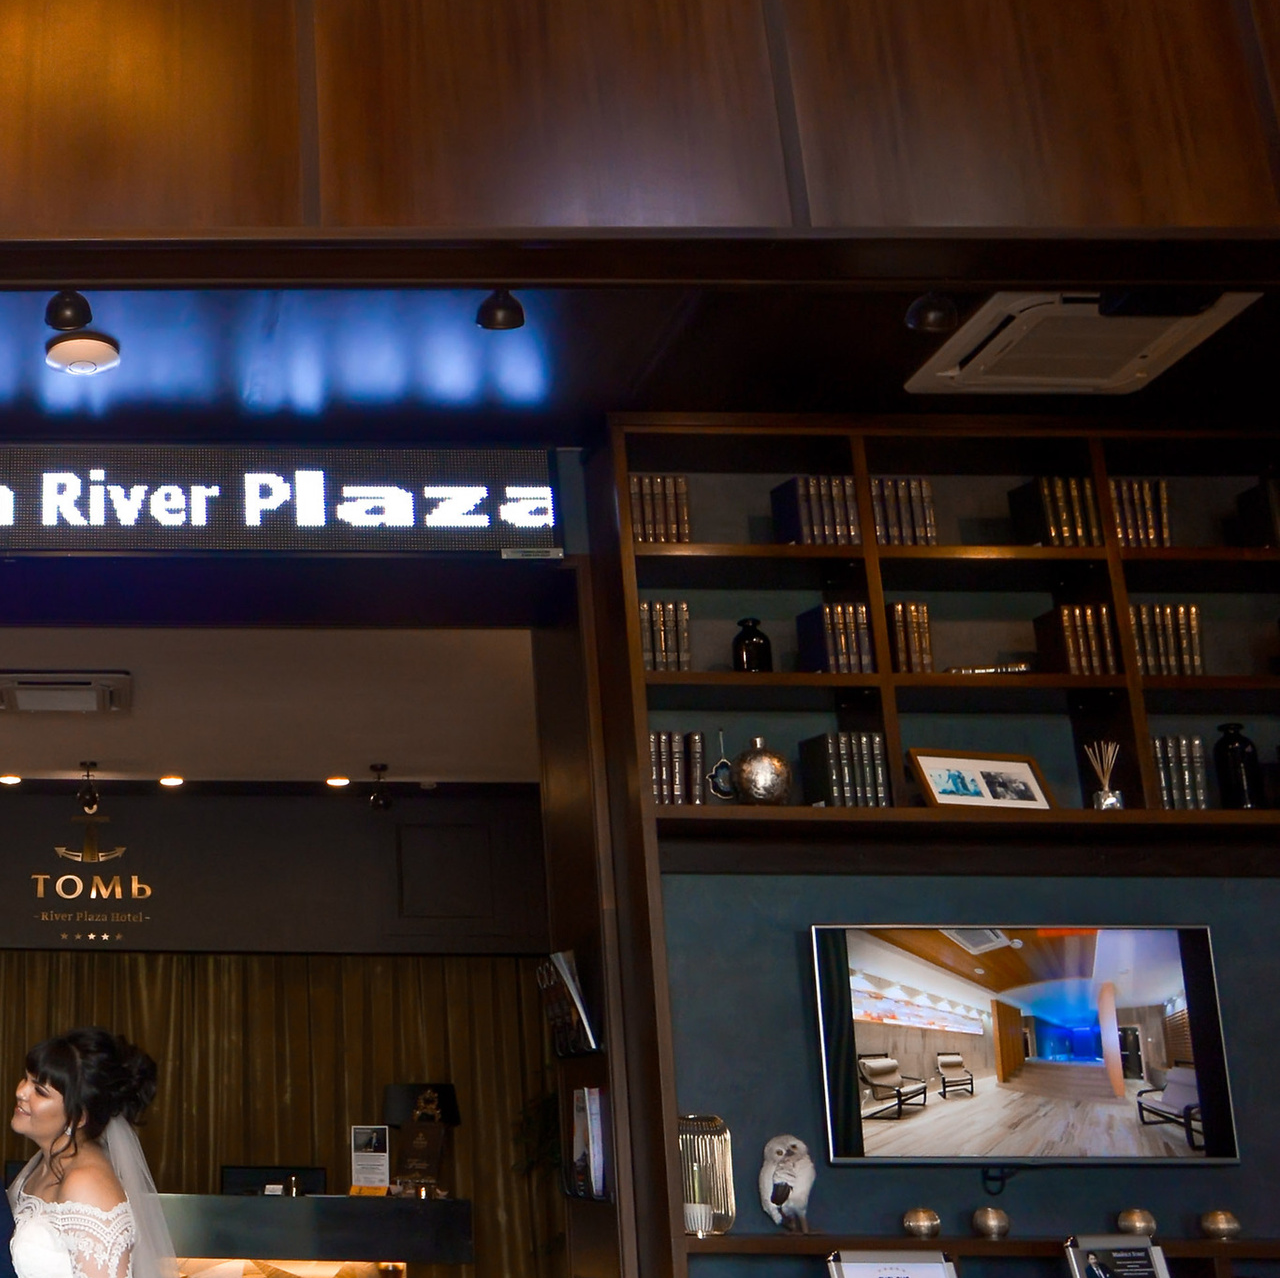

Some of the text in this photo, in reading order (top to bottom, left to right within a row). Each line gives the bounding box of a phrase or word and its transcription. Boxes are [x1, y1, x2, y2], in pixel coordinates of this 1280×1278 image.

[41, 468, 220, 527] River
[244, 469, 555, 528] Plaza
[30, 873, 153, 900] ТОМЬ
[41, 910, 143, 923] River Plaza Hotel
